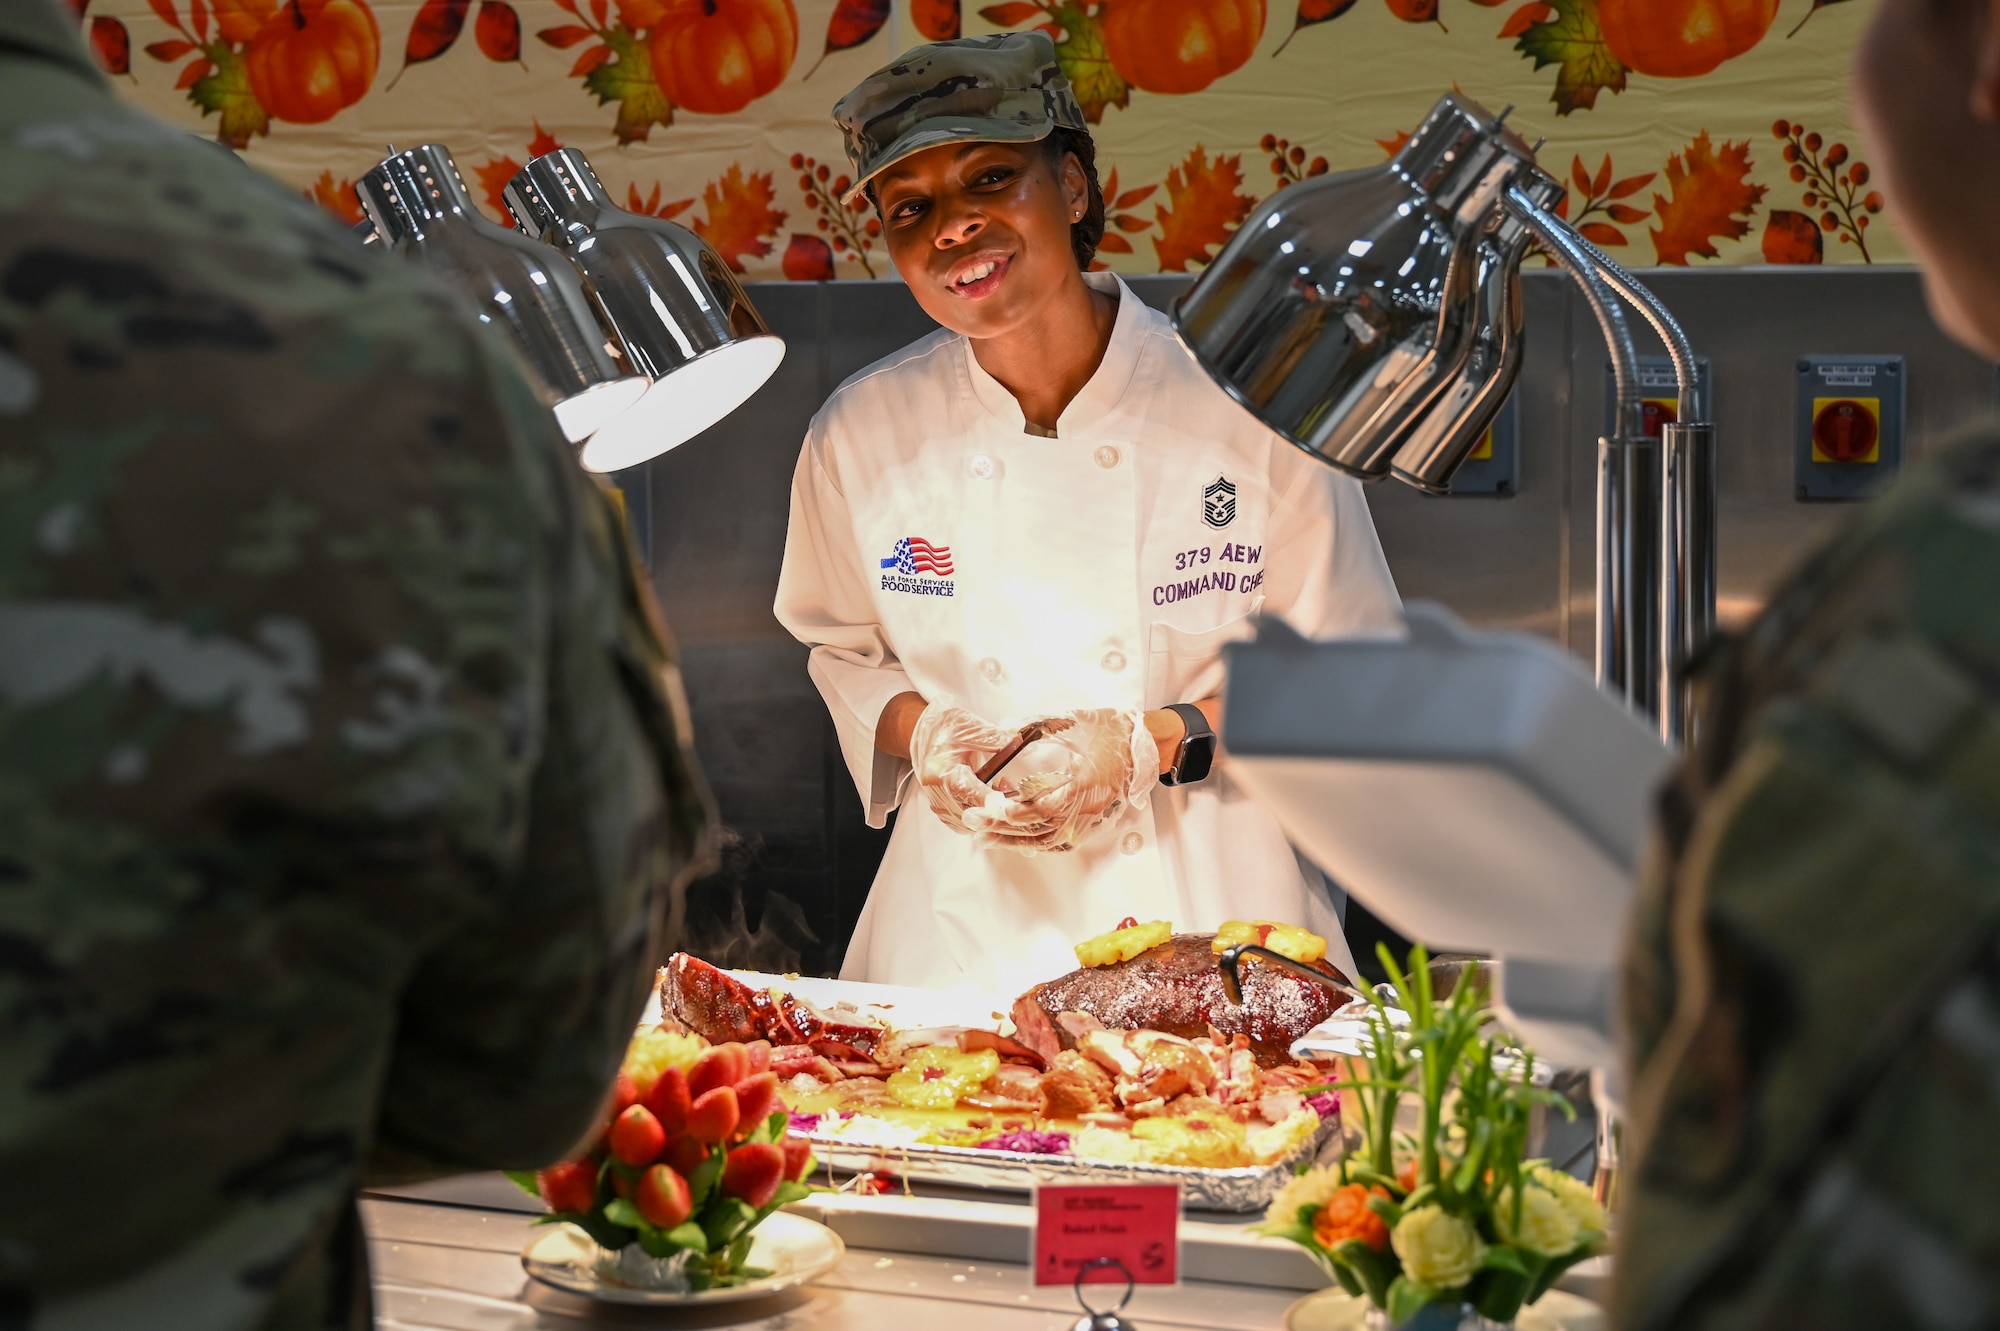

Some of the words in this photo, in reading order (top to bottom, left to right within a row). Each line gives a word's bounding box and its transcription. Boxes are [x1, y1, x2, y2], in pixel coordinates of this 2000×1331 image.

[1175, 546, 1211, 571] 379
[1219, 542, 1262, 564] AEW
[1153, 571, 1236, 606] COMMAND
